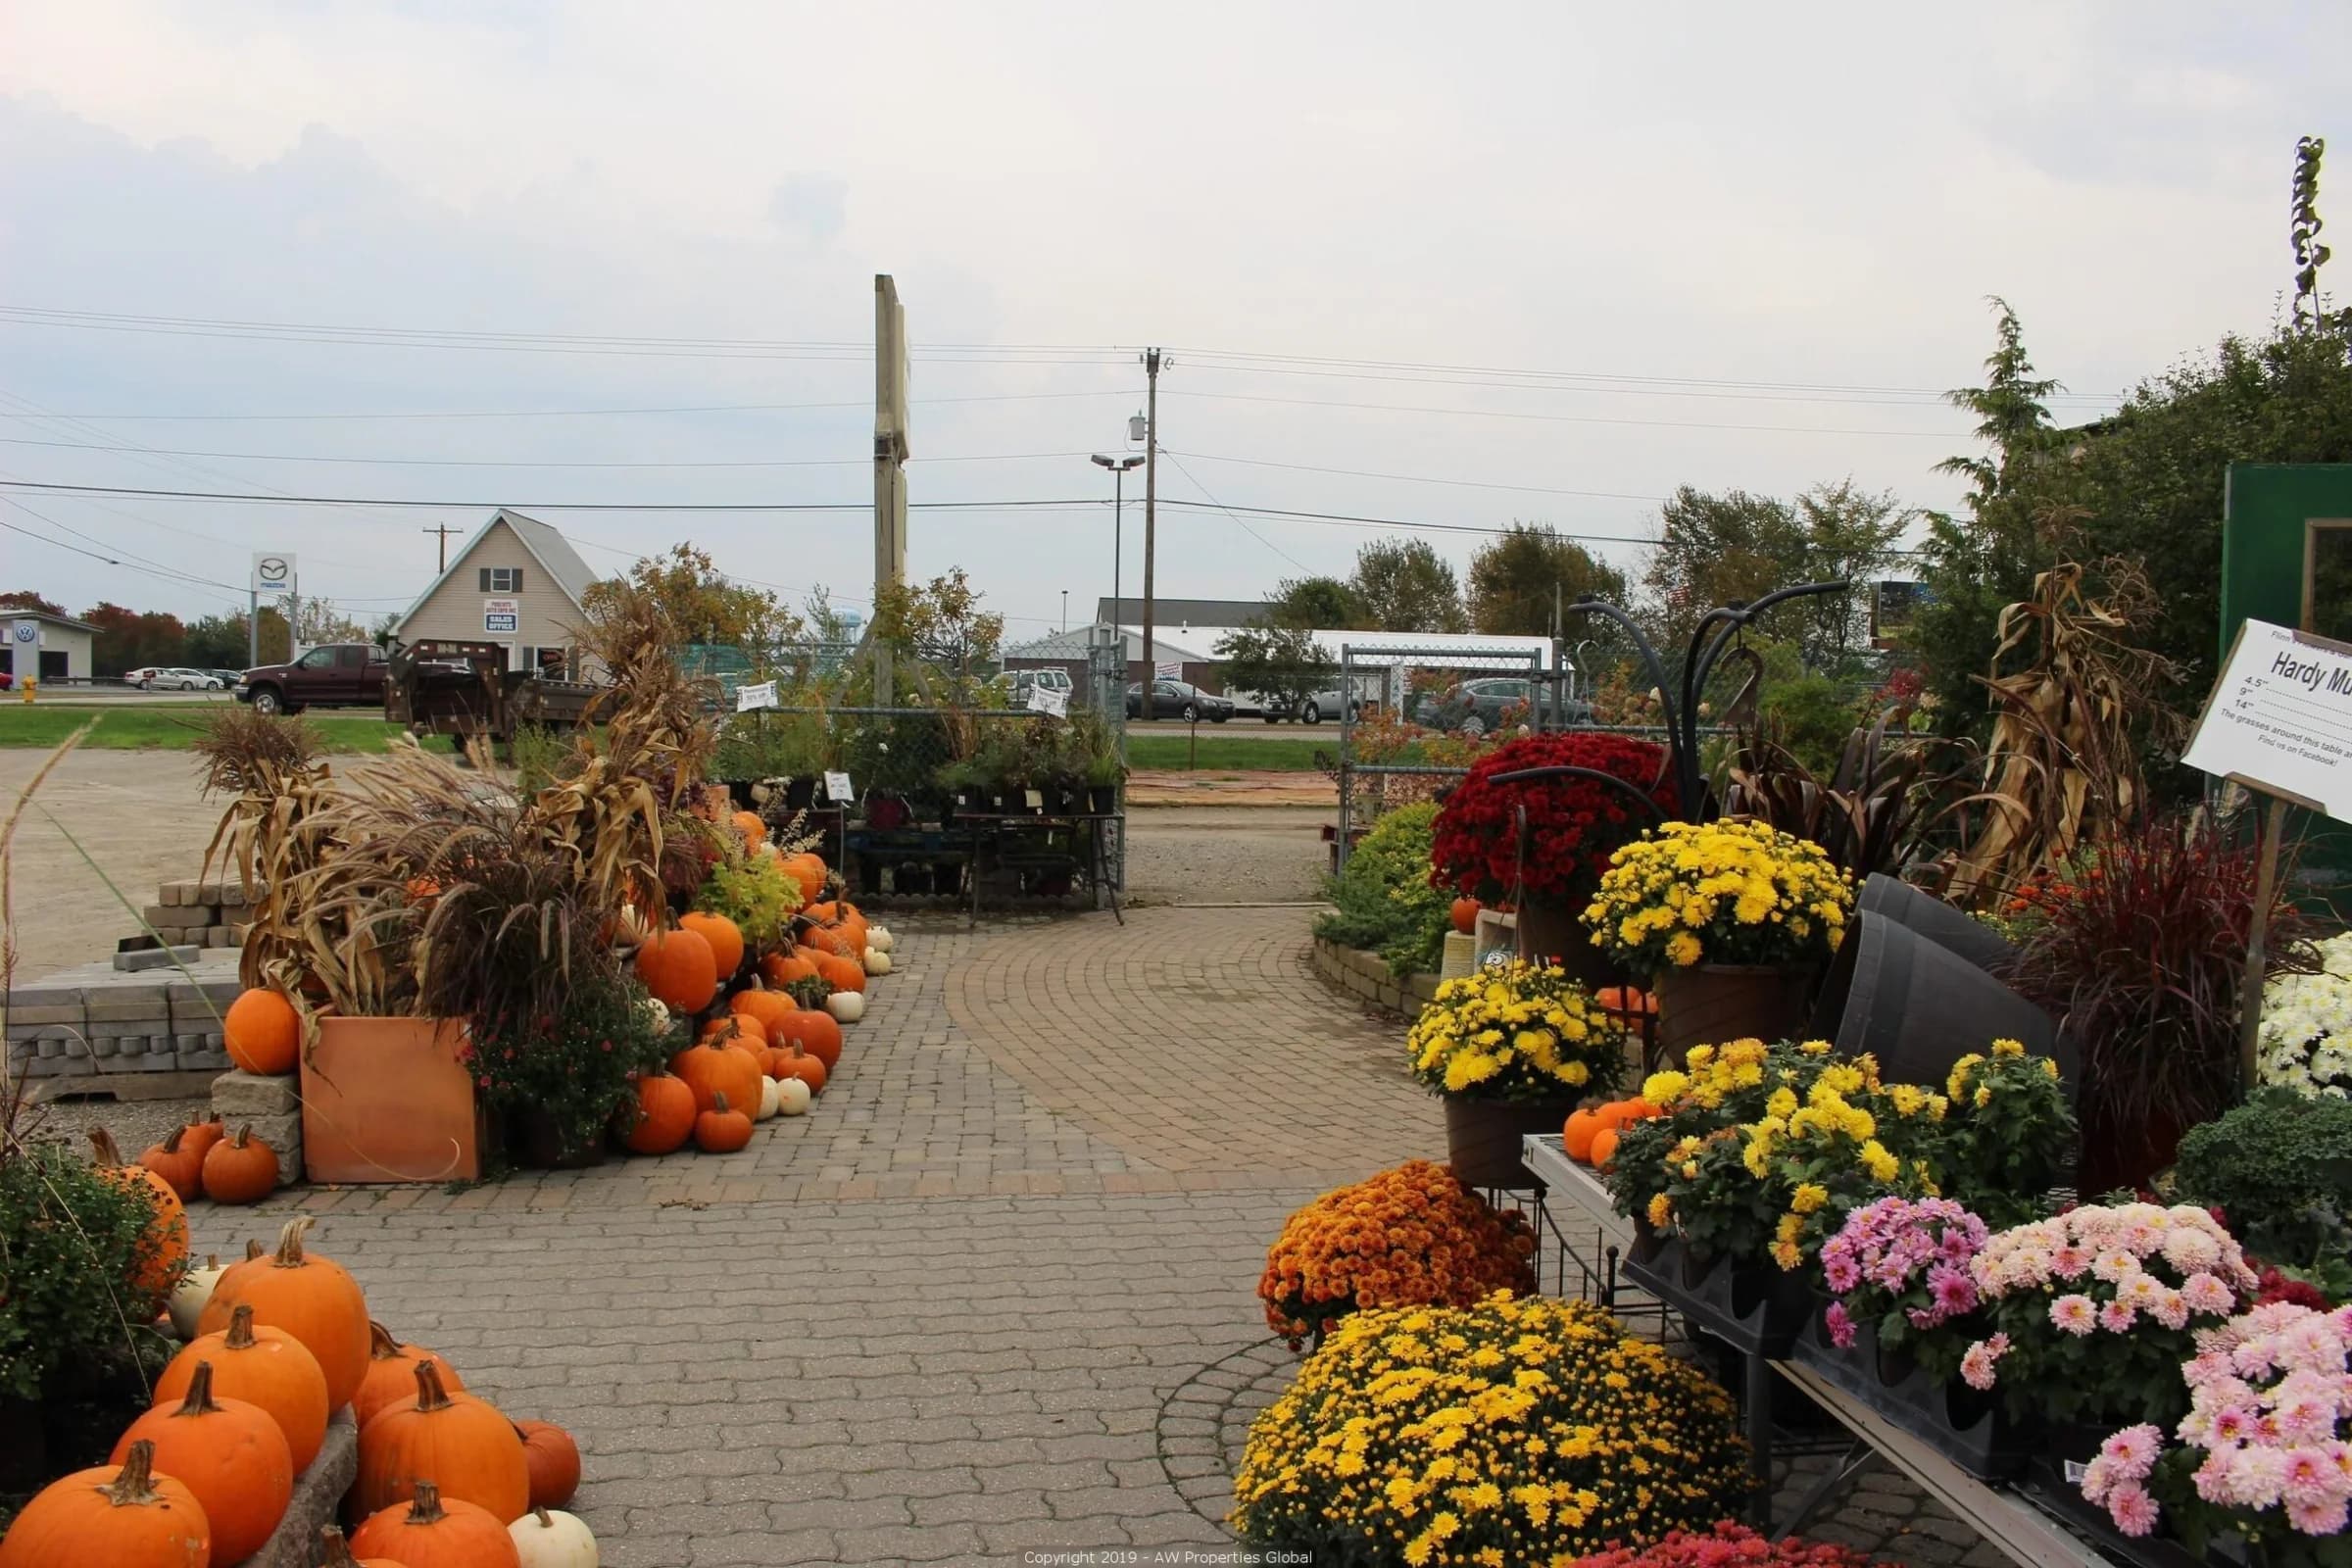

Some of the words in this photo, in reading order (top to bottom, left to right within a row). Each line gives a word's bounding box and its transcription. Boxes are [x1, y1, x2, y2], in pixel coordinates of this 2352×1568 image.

[2271, 651, 2328, 692] Hardy
[2221, 708, 2235, 719] The
[2236, 714, 2270, 731] grasses
[2271, 727, 2303, 742] around
[2303, 736, 2320, 748] this
[2321, 742, 2343, 756] table
[2257, 733, 2277, 747] Find
[2276, 742, 2286, 751] us
[2286, 745, 2297, 754] on
[2297, 748, 2338, 767] Facebook!
